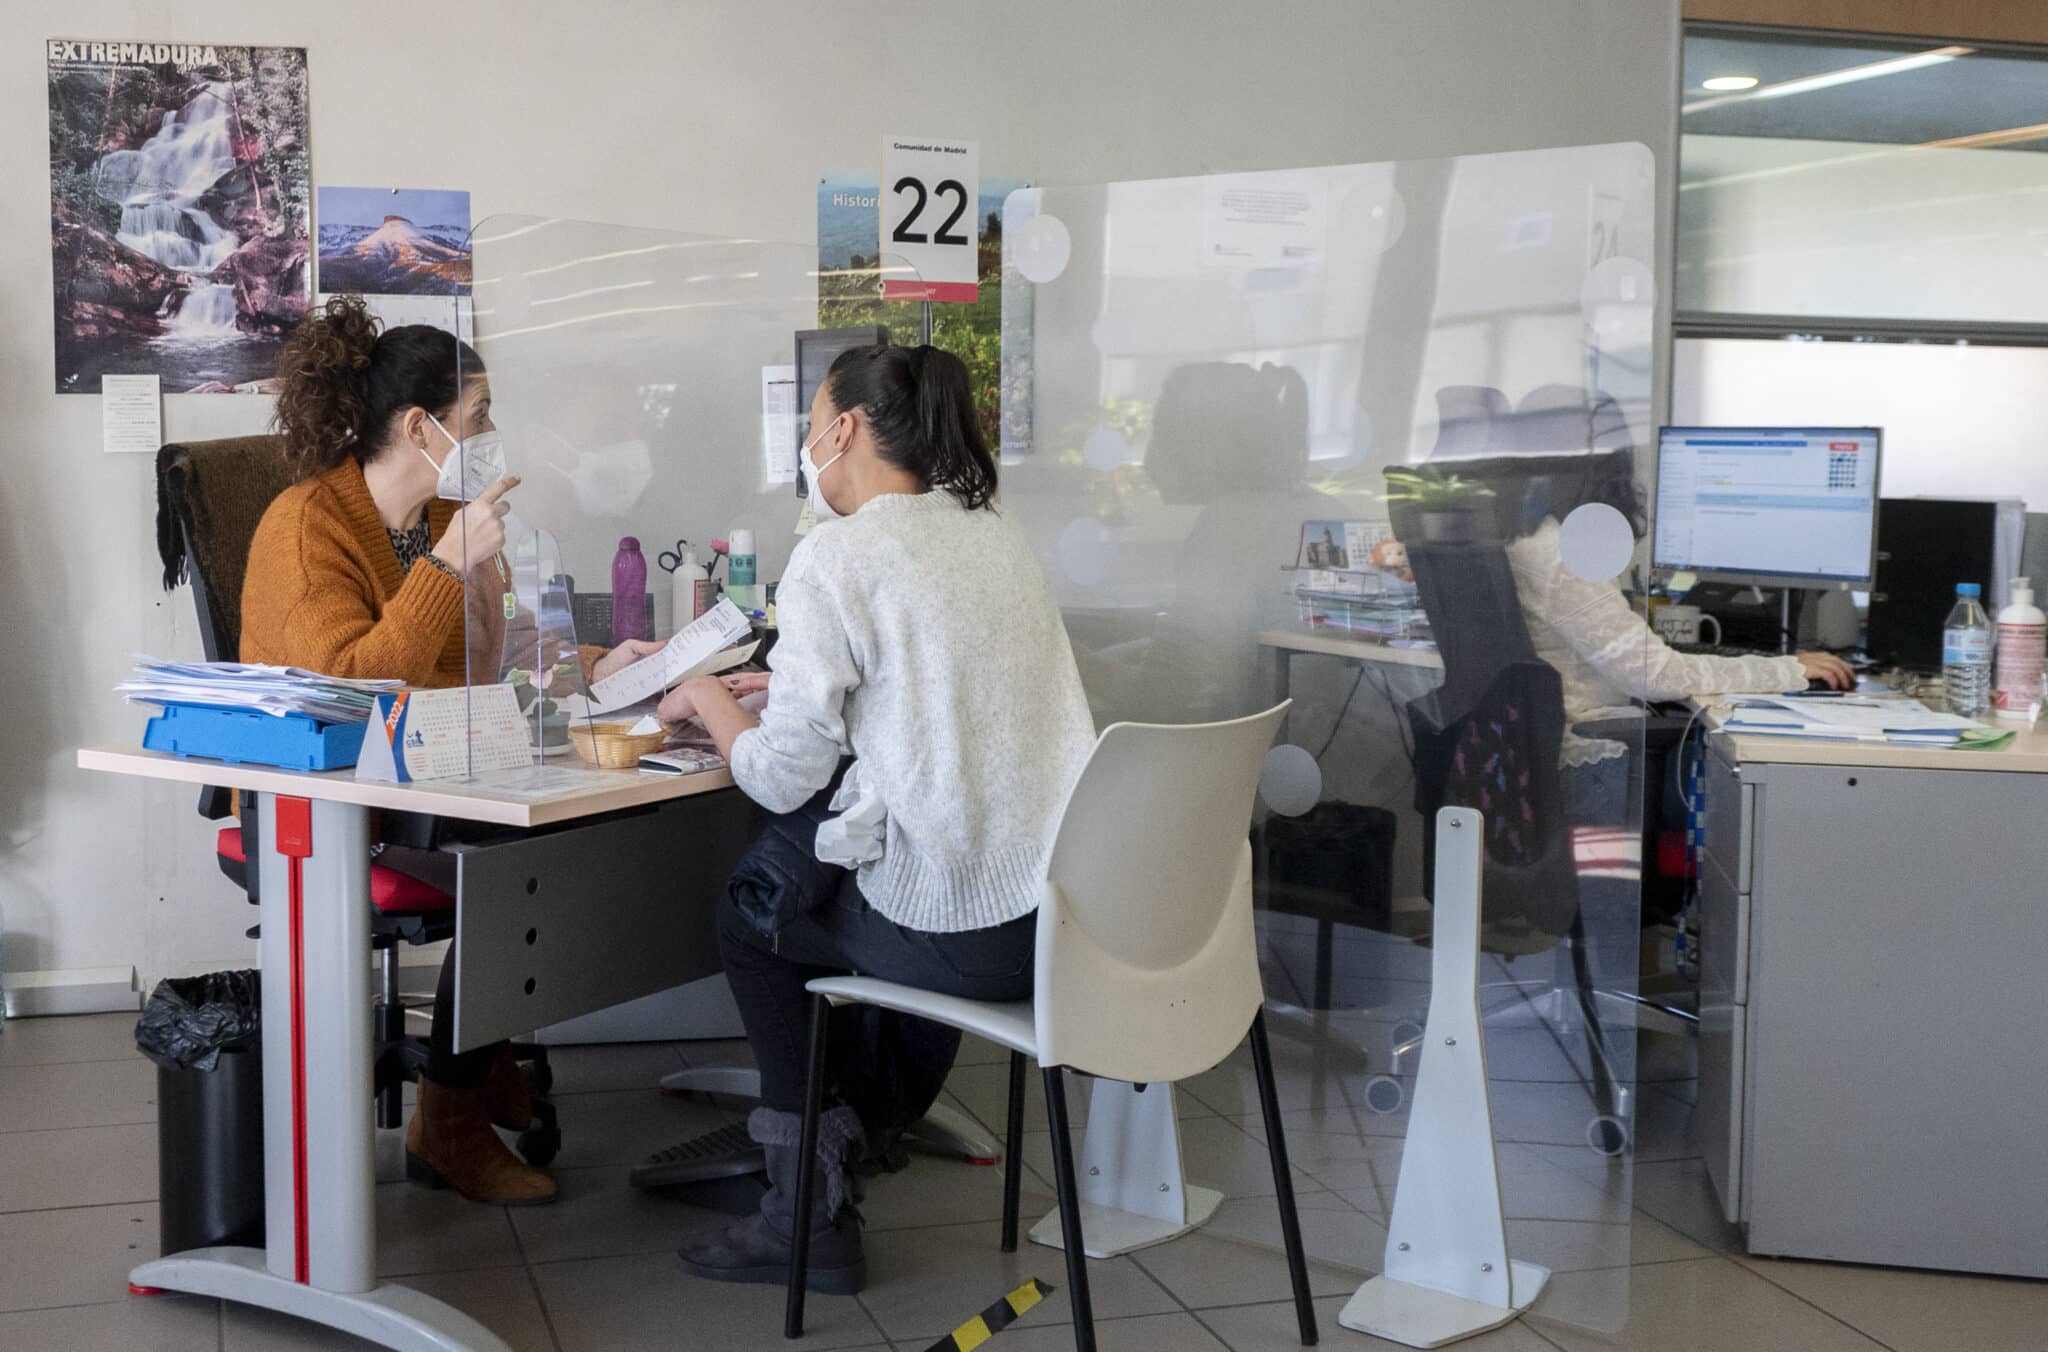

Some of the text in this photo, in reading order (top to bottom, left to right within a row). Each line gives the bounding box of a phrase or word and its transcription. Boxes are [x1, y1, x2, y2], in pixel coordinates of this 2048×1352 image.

[48, 41, 218, 65] EXTREMADURA
[894, 142, 967, 155] Comunidad de Madrid
[893, 177, 968, 245] 22
[386, 701, 405, 731] 2022
